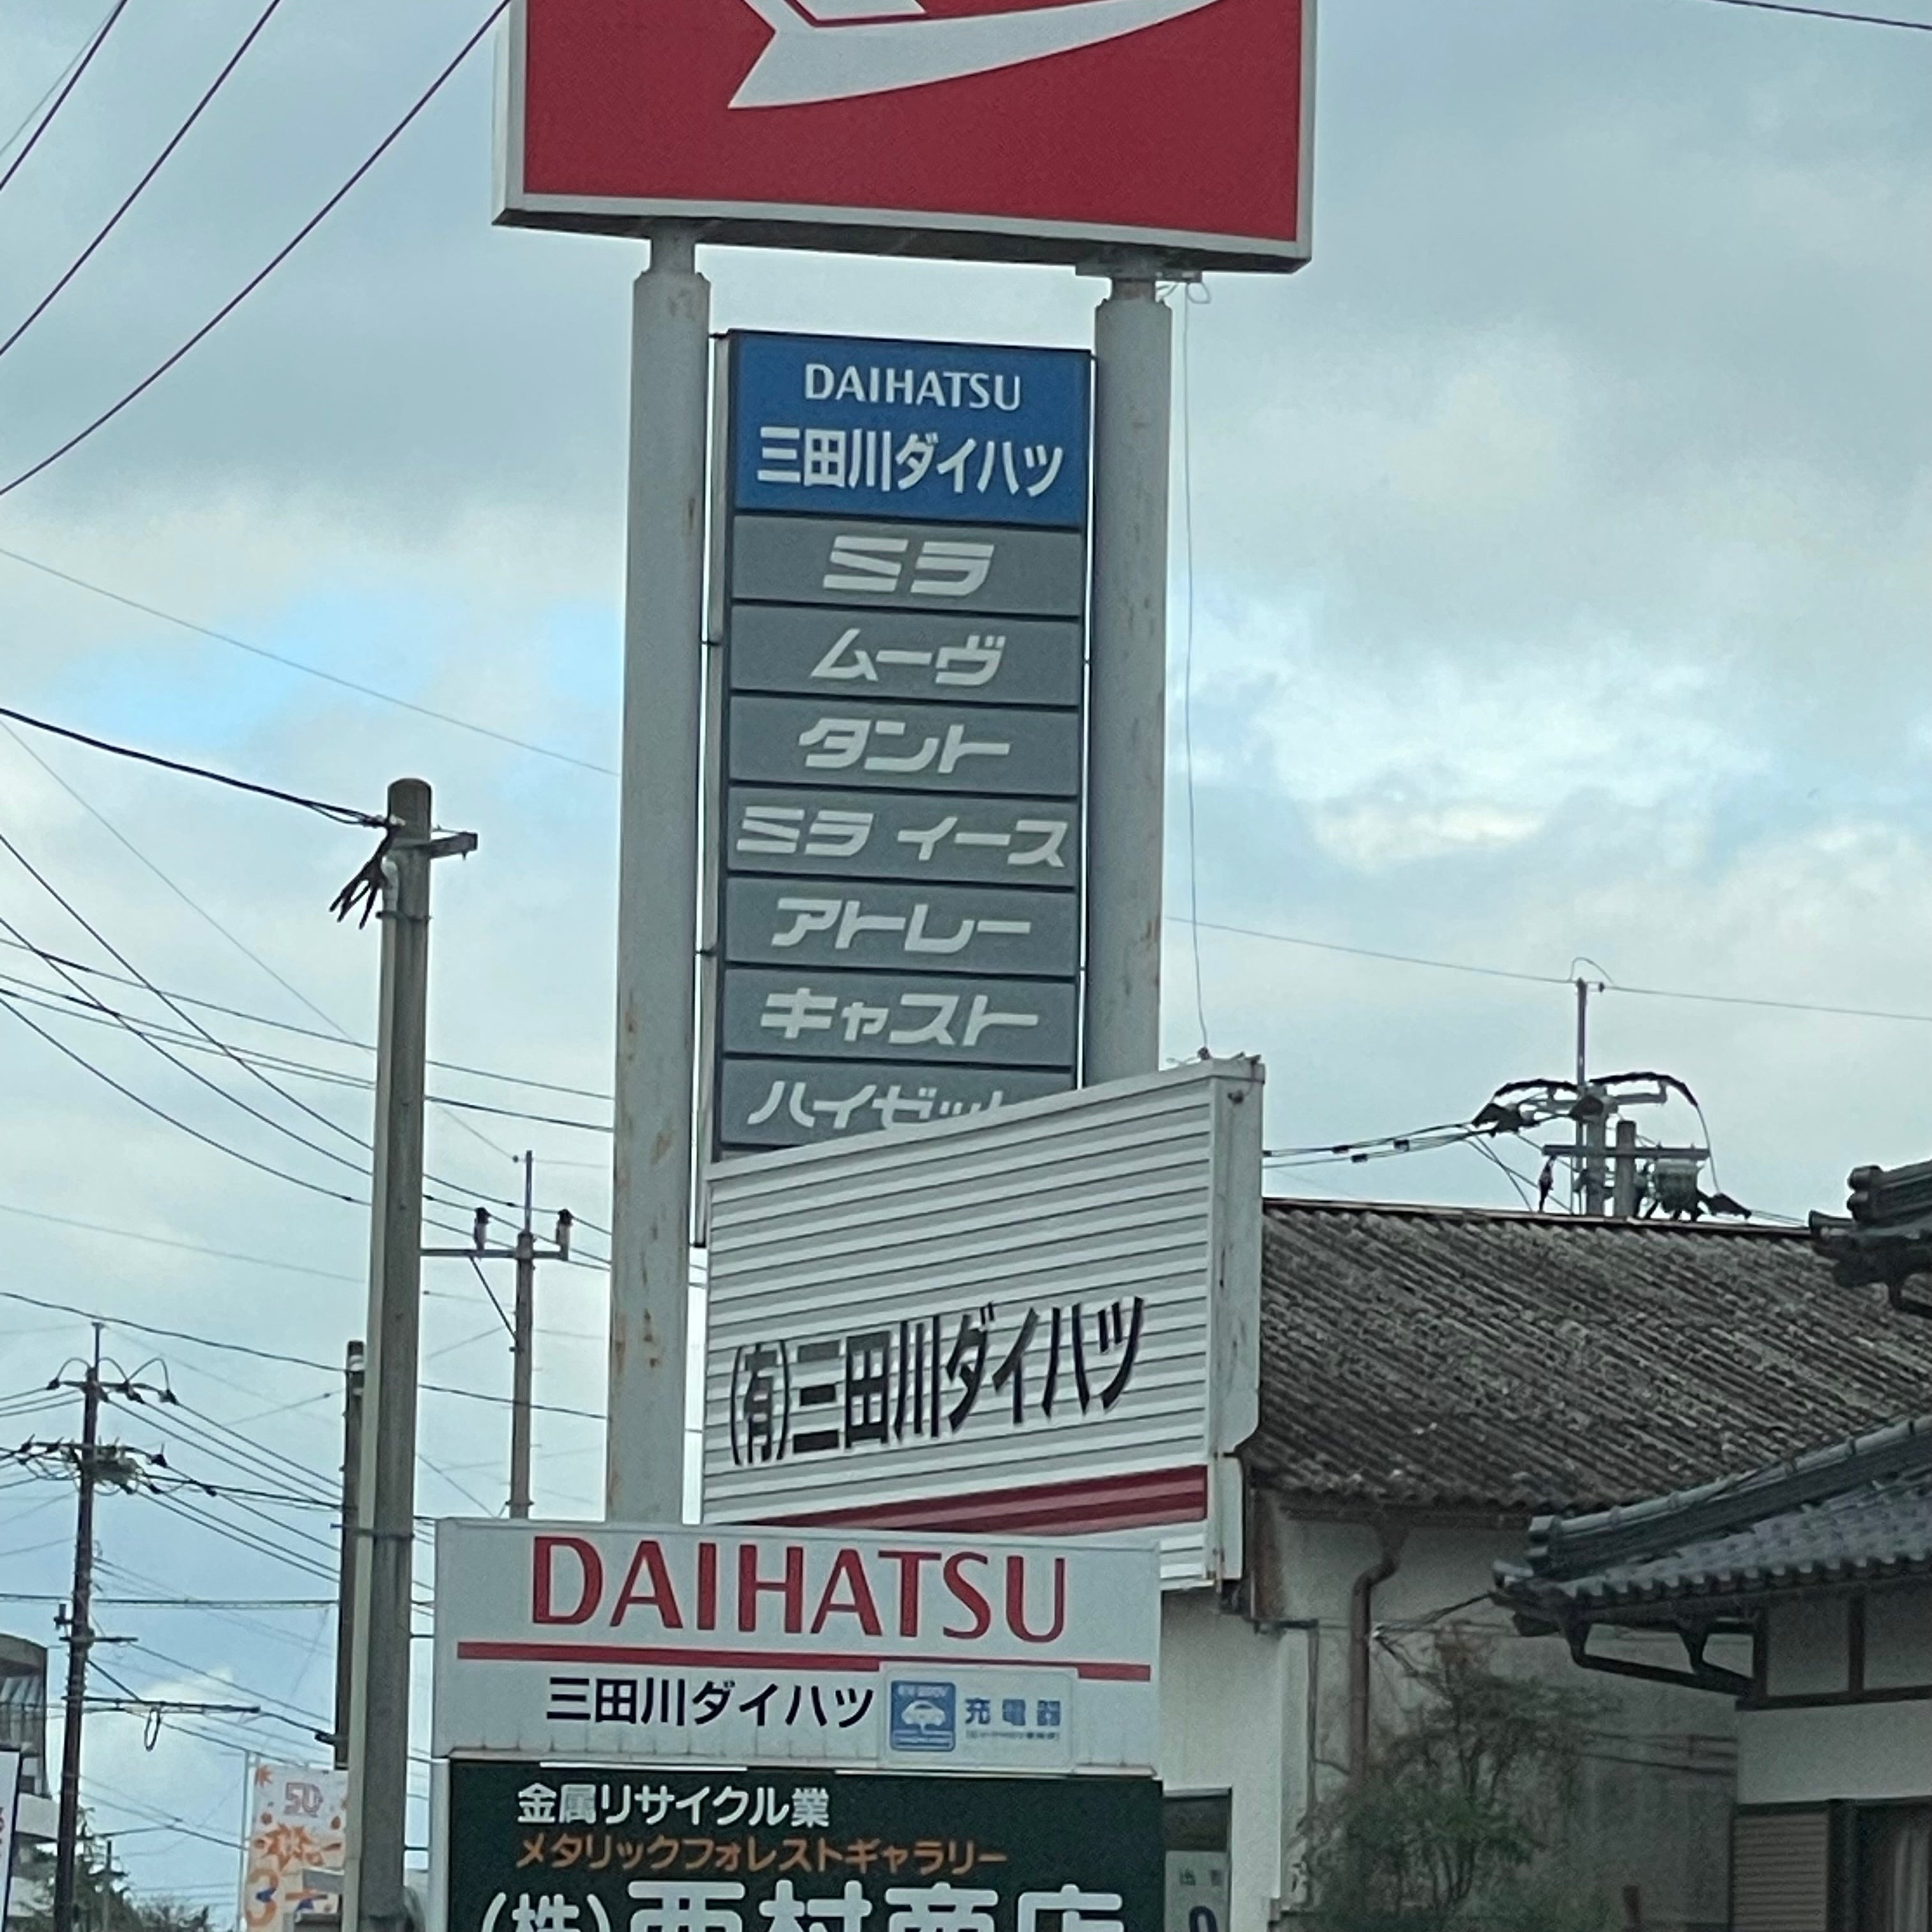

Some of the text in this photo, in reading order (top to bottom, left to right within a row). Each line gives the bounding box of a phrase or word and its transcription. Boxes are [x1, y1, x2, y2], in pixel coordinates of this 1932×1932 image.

[805, 363, 1022, 410] DAIHATSU
[757, 425, 1063, 497] 三田川ダイハツ
[823, 535, 995, 596] ミラ
[810, 627, 1006, 686] ムーヴ
[799, 717, 1011, 774] タント
[736, 806, 1068, 868] ミラ イース
[770, 898, 1032, 954] アトレー
[760, 987, 1039, 1046] キャスト
[532, 1535, 1065, 1643] DAIHATSU
[546, 1677, 873, 1728] 三田川ダイハツ
[516, 1782, 830, 1828] 金属リサイクル業
[516, 1833, 1008, 1875] メタリックフォレストギャラリー
